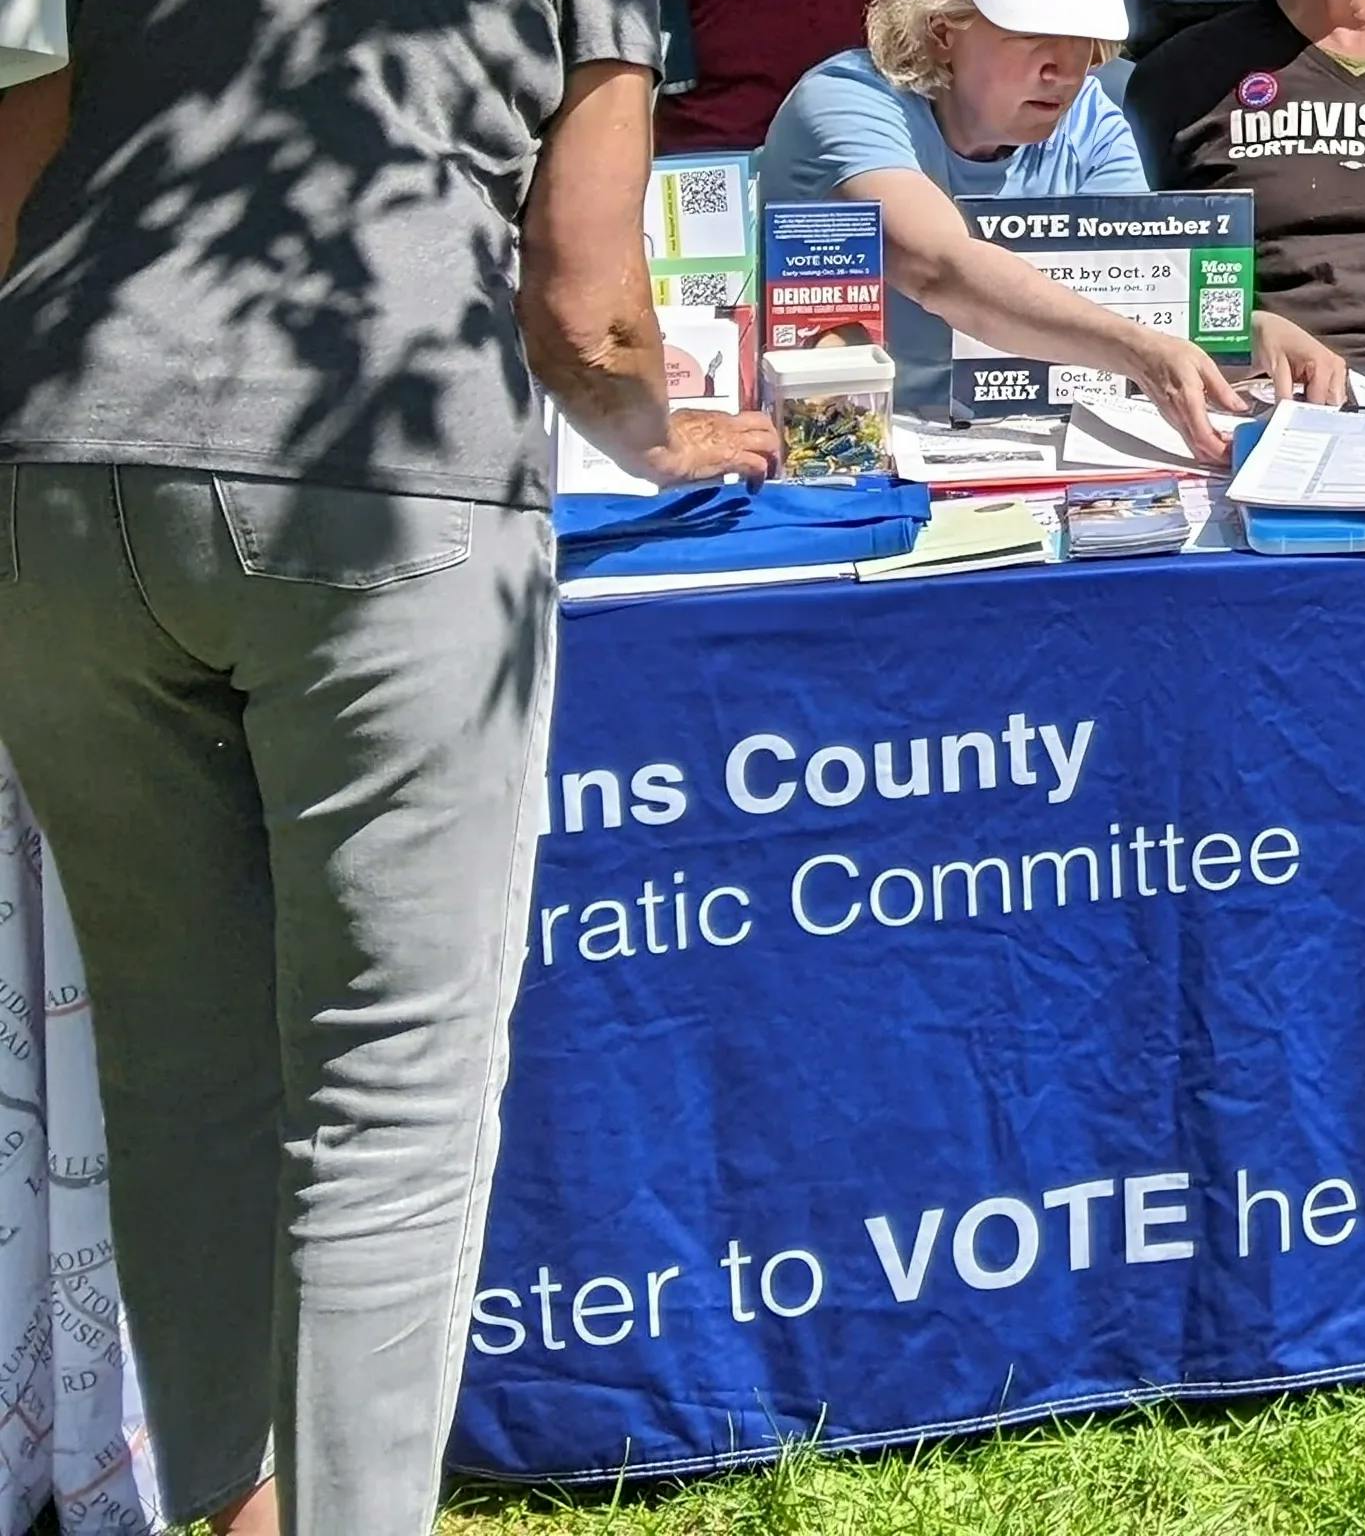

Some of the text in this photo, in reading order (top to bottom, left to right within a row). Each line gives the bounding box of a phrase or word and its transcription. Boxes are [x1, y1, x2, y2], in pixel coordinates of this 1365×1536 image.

[1228, 139, 1365, 159] CORTLAND
[976, 214, 1231, 240] VOTE November 7
[785, 254, 866, 267] VOTE NOV. 7
[1200, 261, 1242, 274] More
[1080, 267, 1101, 283] by
[1108, 266, 1145, 279] Oct.
[1152, 265, 1171, 278] 28
[1206, 273, 1238, 285] Info
[772, 285, 879, 305] DEIRDRE HAY
[1153, 312, 1173, 324] 23
[974, 369, 1113, 385] VOTE Oct. 28
[974, 385, 1040, 402] EARLY
[1055, 387, 1069, 397] to
[1110, 384, 1117, 395] 5
[725, 713, 1094, 815] County
[528, 827, 1299, 966] ratic Committee
[721, 1239, 822, 1322] to
[864, 1172, 1194, 1302] VOTE
[62, 1371, 97, 1393] RD
